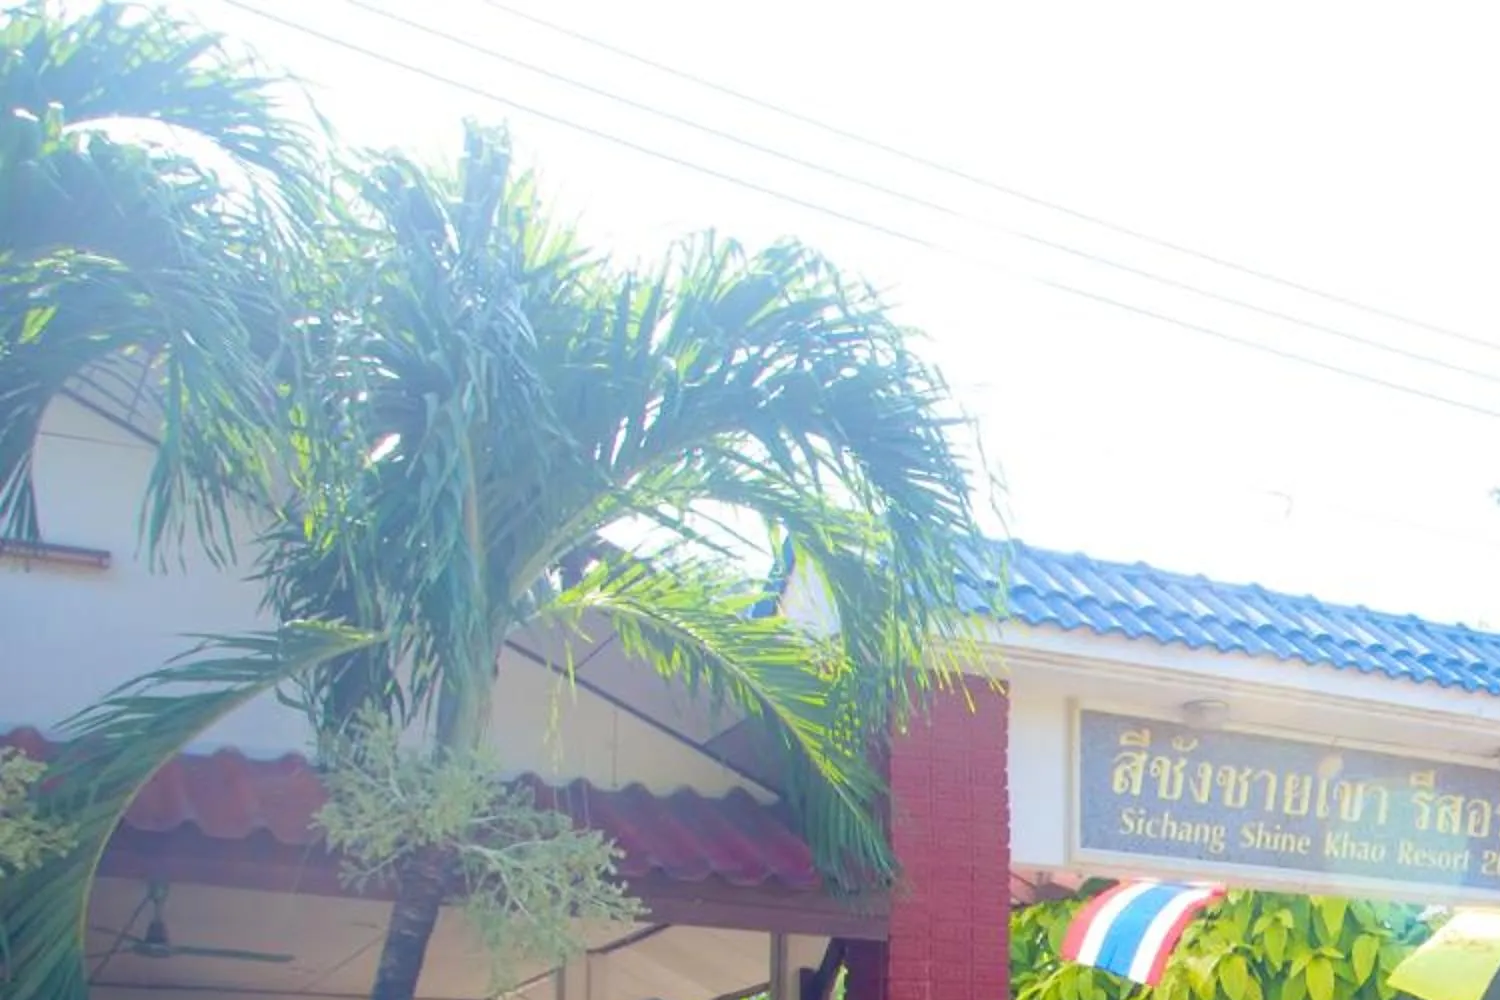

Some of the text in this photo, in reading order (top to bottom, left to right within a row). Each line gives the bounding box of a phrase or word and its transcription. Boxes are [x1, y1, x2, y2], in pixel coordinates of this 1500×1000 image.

[1111, 727, 1388, 826] สีชังชายเขา
[1118, 806, 1226, 855] Sichang
[1240, 820, 1312, 857] Shine
[1323, 830, 1387, 864] Khao
[1396, 840, 1471, 873] Resort
